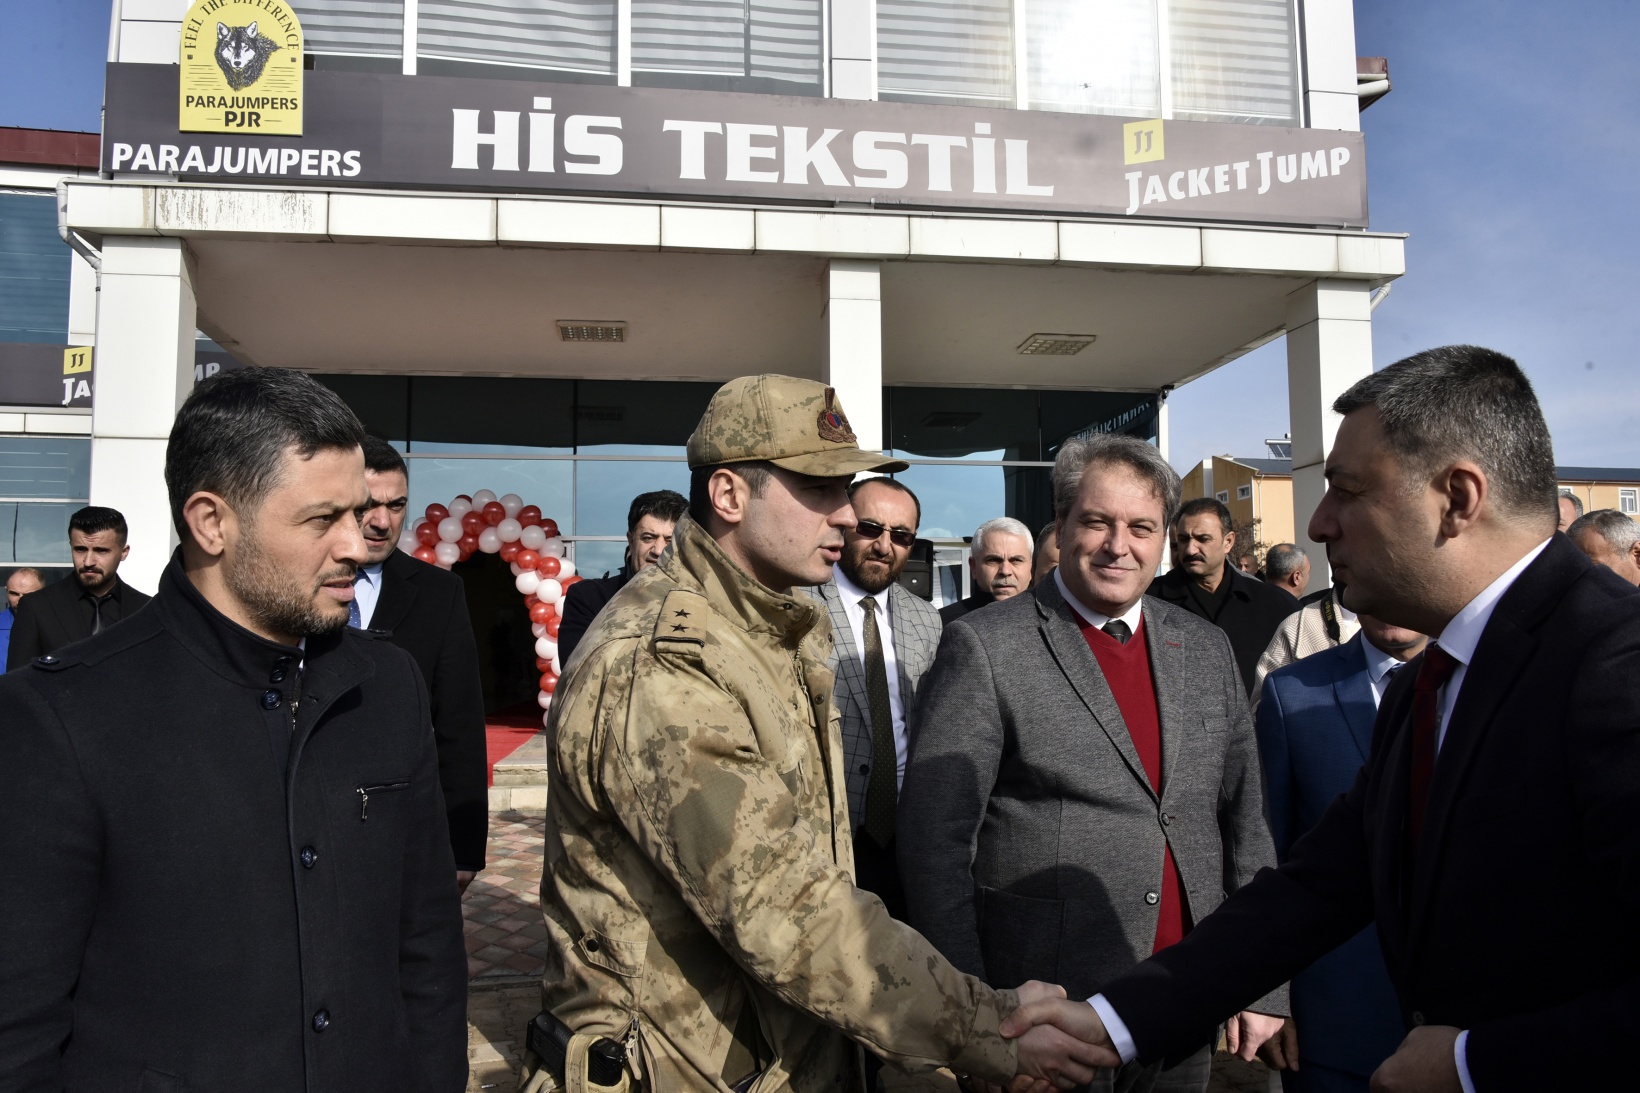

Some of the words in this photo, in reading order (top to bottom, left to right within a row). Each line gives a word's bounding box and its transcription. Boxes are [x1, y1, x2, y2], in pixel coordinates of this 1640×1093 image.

[185, 18, 204, 49] FEEL
[200, 0, 227, 16] THE
[186, 95, 298, 110] PARAJUMPERS
[224, 111, 261, 127] PJR
[1134, 130, 1154, 155] JJ
[112, 143, 361, 177] PARAJUMPERS
[662, 120, 1055, 197] TEKSTİL
[71, 353, 85, 368] JJ
